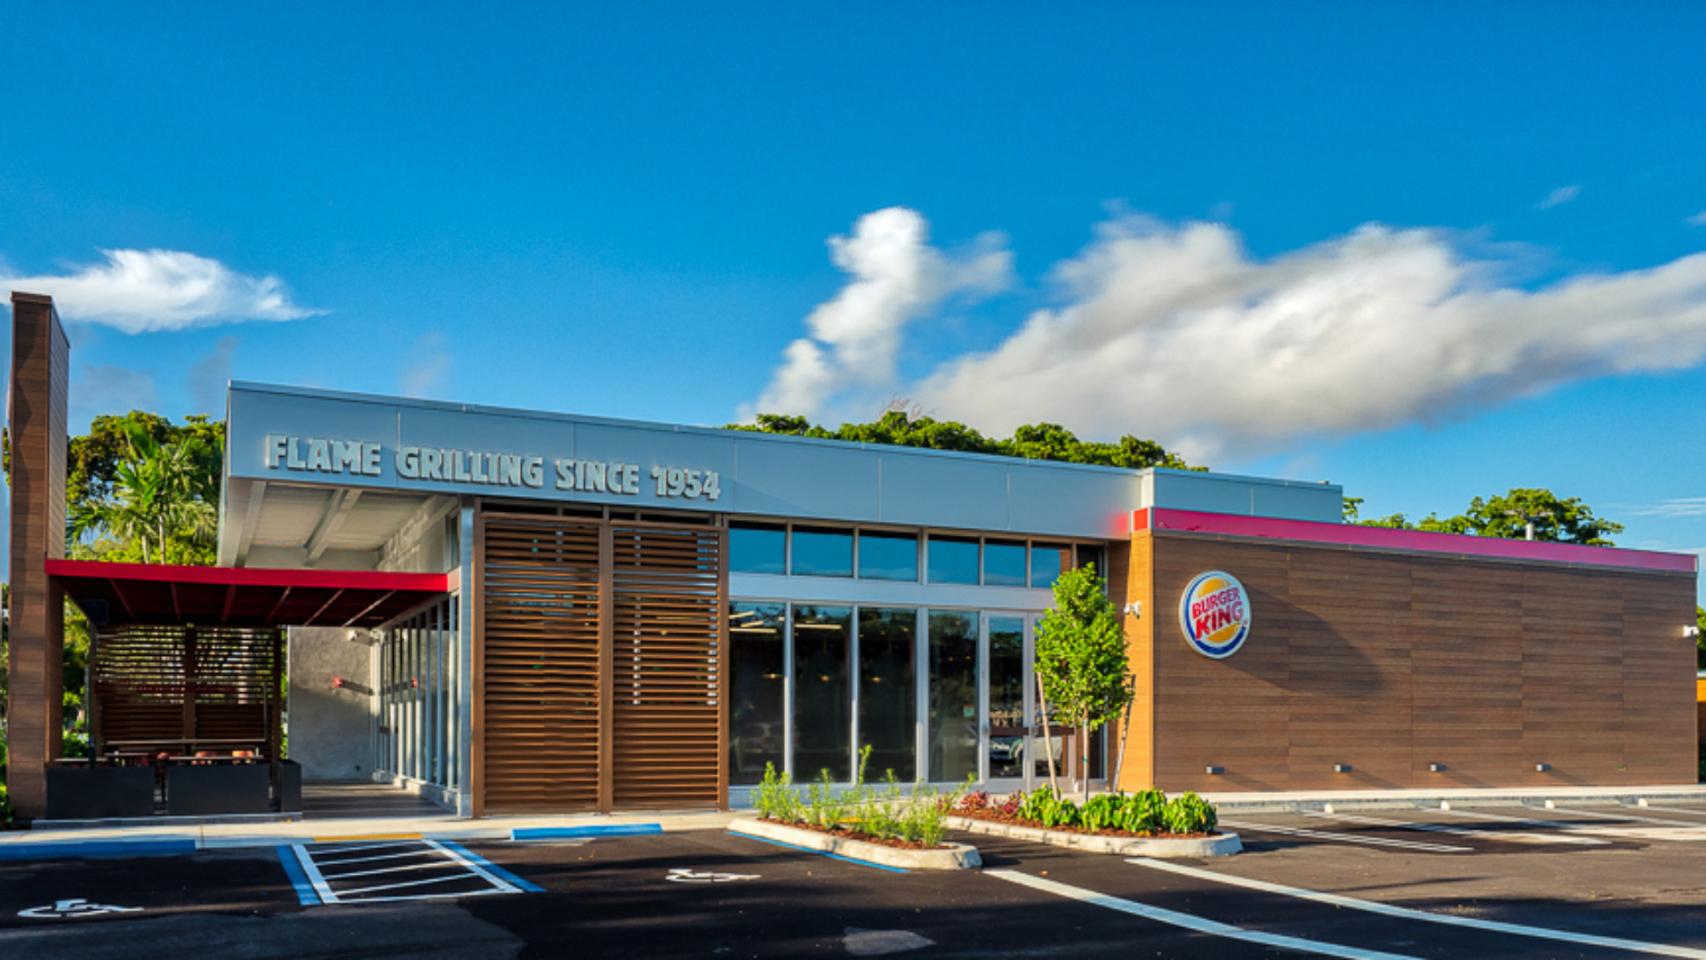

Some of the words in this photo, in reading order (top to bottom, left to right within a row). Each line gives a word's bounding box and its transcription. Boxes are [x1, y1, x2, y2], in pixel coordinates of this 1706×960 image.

[265, 434, 381, 475] FLAME
[396, 447, 543, 487] GRILLING
[555, 458, 639, 495] SINCE
[651, 466, 720, 500] 1954
[1192, 587, 1240, 619] BURGER
[1195, 601, 1244, 640] KING
